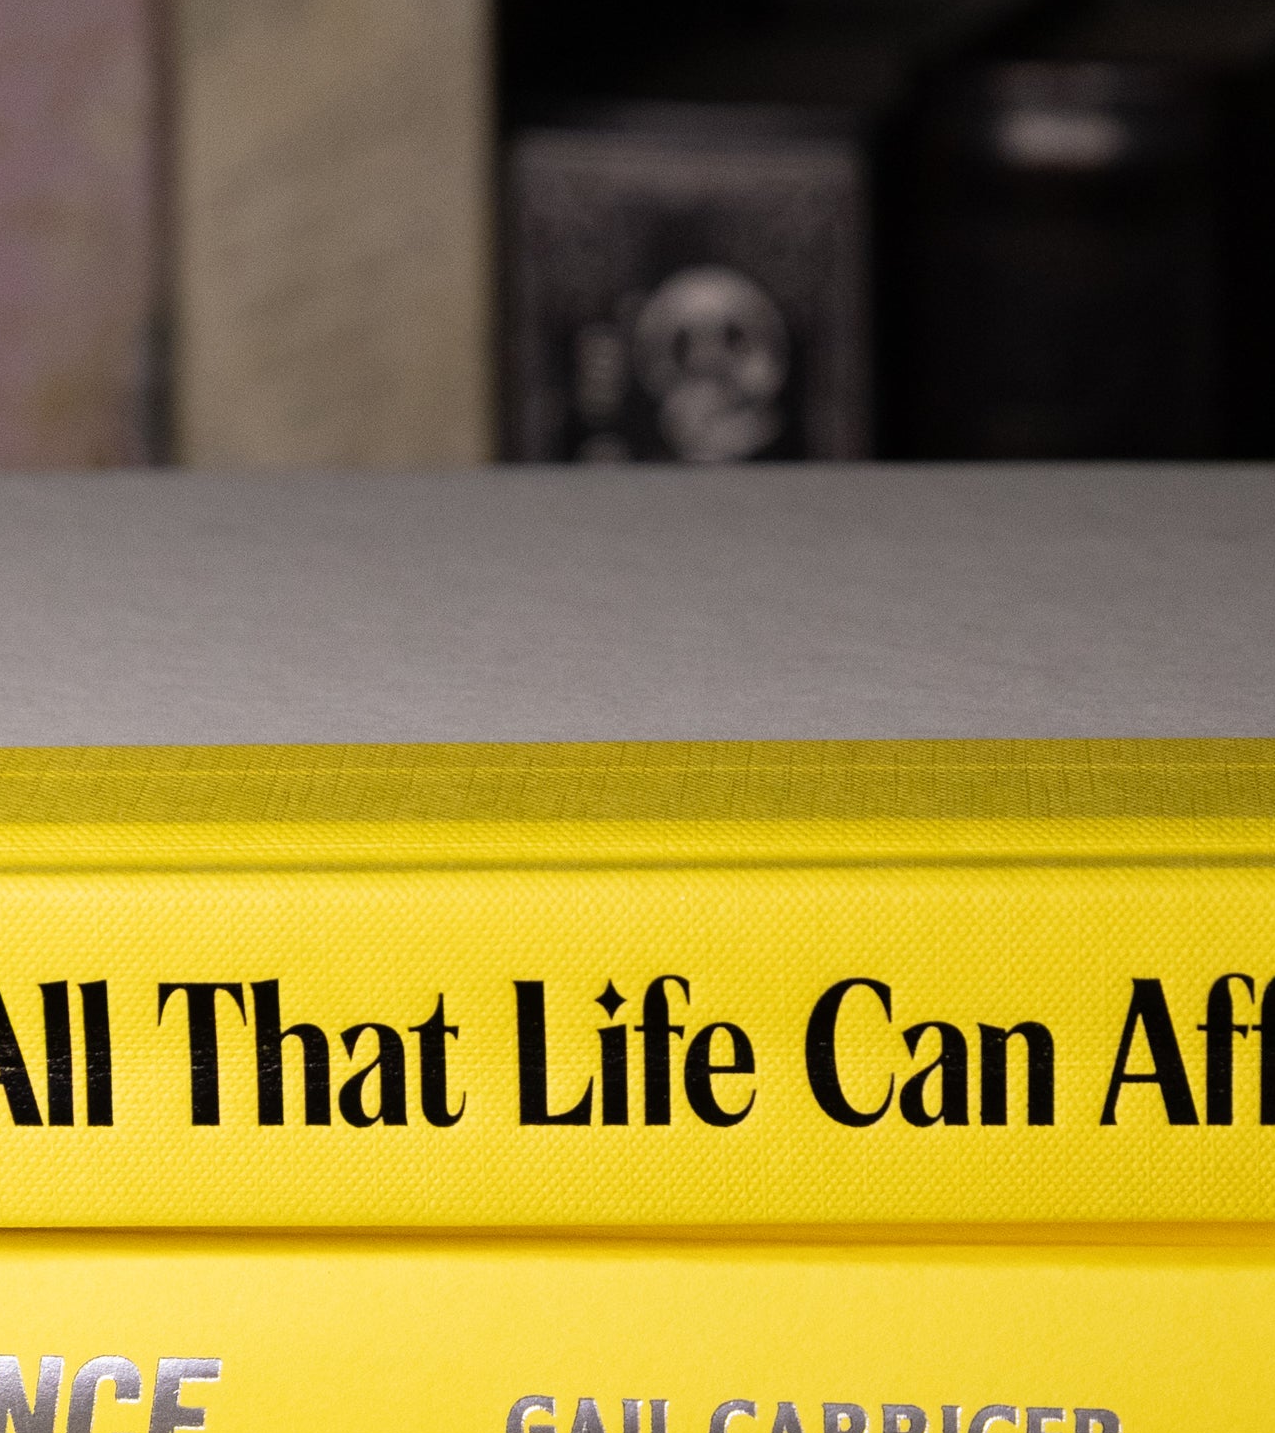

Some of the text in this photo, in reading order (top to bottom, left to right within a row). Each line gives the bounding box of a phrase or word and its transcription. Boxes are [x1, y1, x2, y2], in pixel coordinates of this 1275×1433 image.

[158, 980, 467, 1129] That
[514, 976, 758, 1127] Life
[804, 977, 1057, 1127] Can
